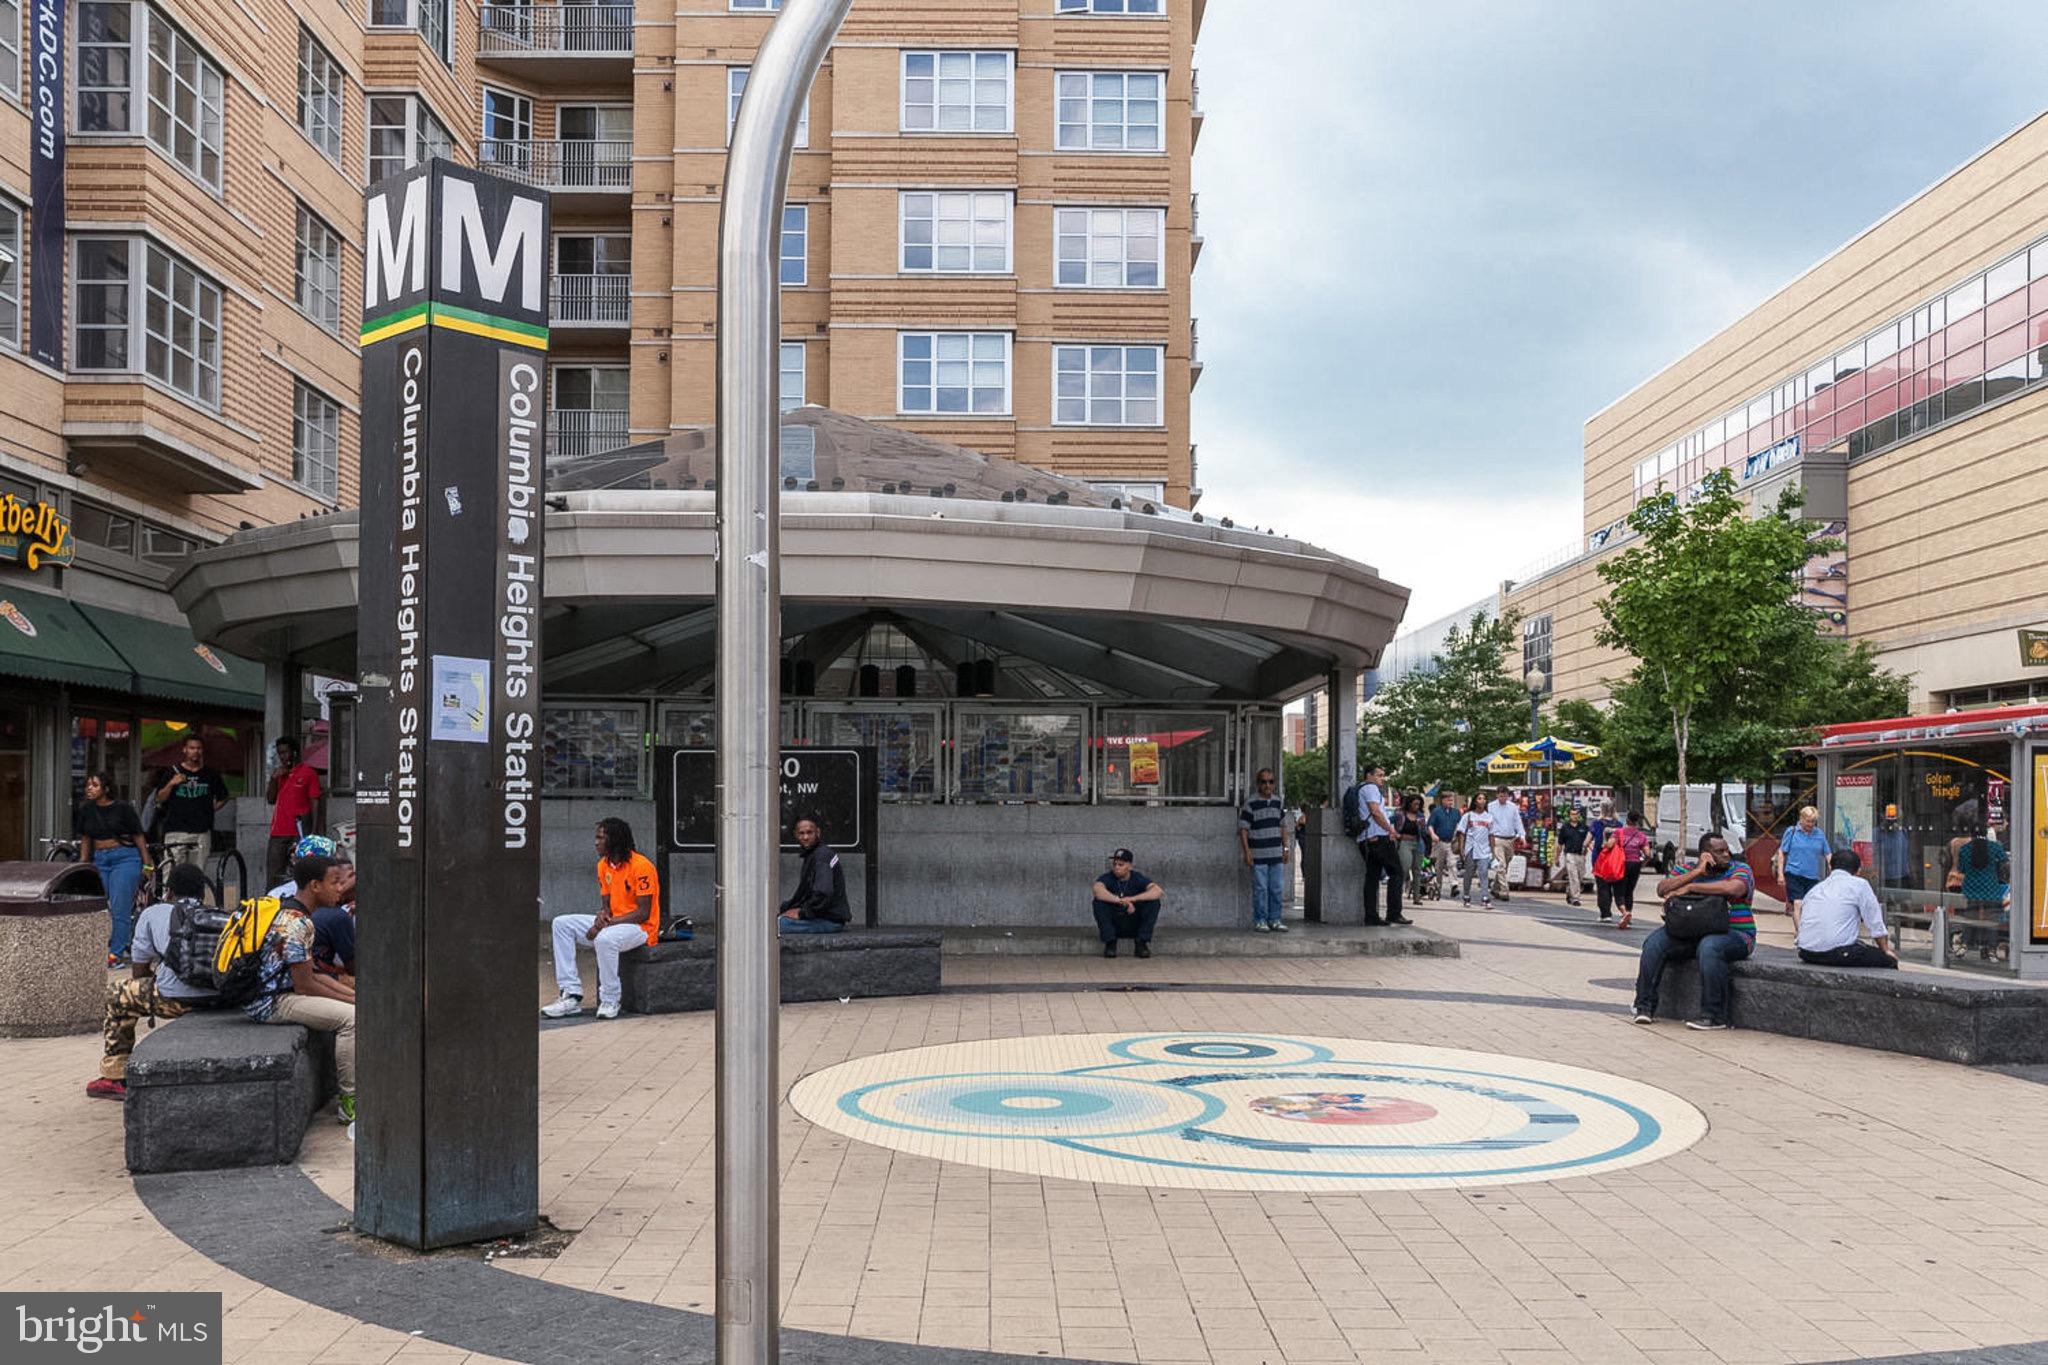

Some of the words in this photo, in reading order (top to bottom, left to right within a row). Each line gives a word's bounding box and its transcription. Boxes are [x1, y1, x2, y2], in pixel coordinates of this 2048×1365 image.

[366, 175, 428, 310] M
[441, 175, 543, 312] M
[402, 347, 422, 531] Columbia
[508, 363, 538, 545] Columbi
[398, 544, 420, 693] Heights
[501, 553, 535, 699] Heights
[397, 707, 418, 848] Station
[504, 712, 534, 849] Station
[779, 783, 792, 796] t,
[797, 783, 819, 794] NW
[638, 875, 651, 891] 3
